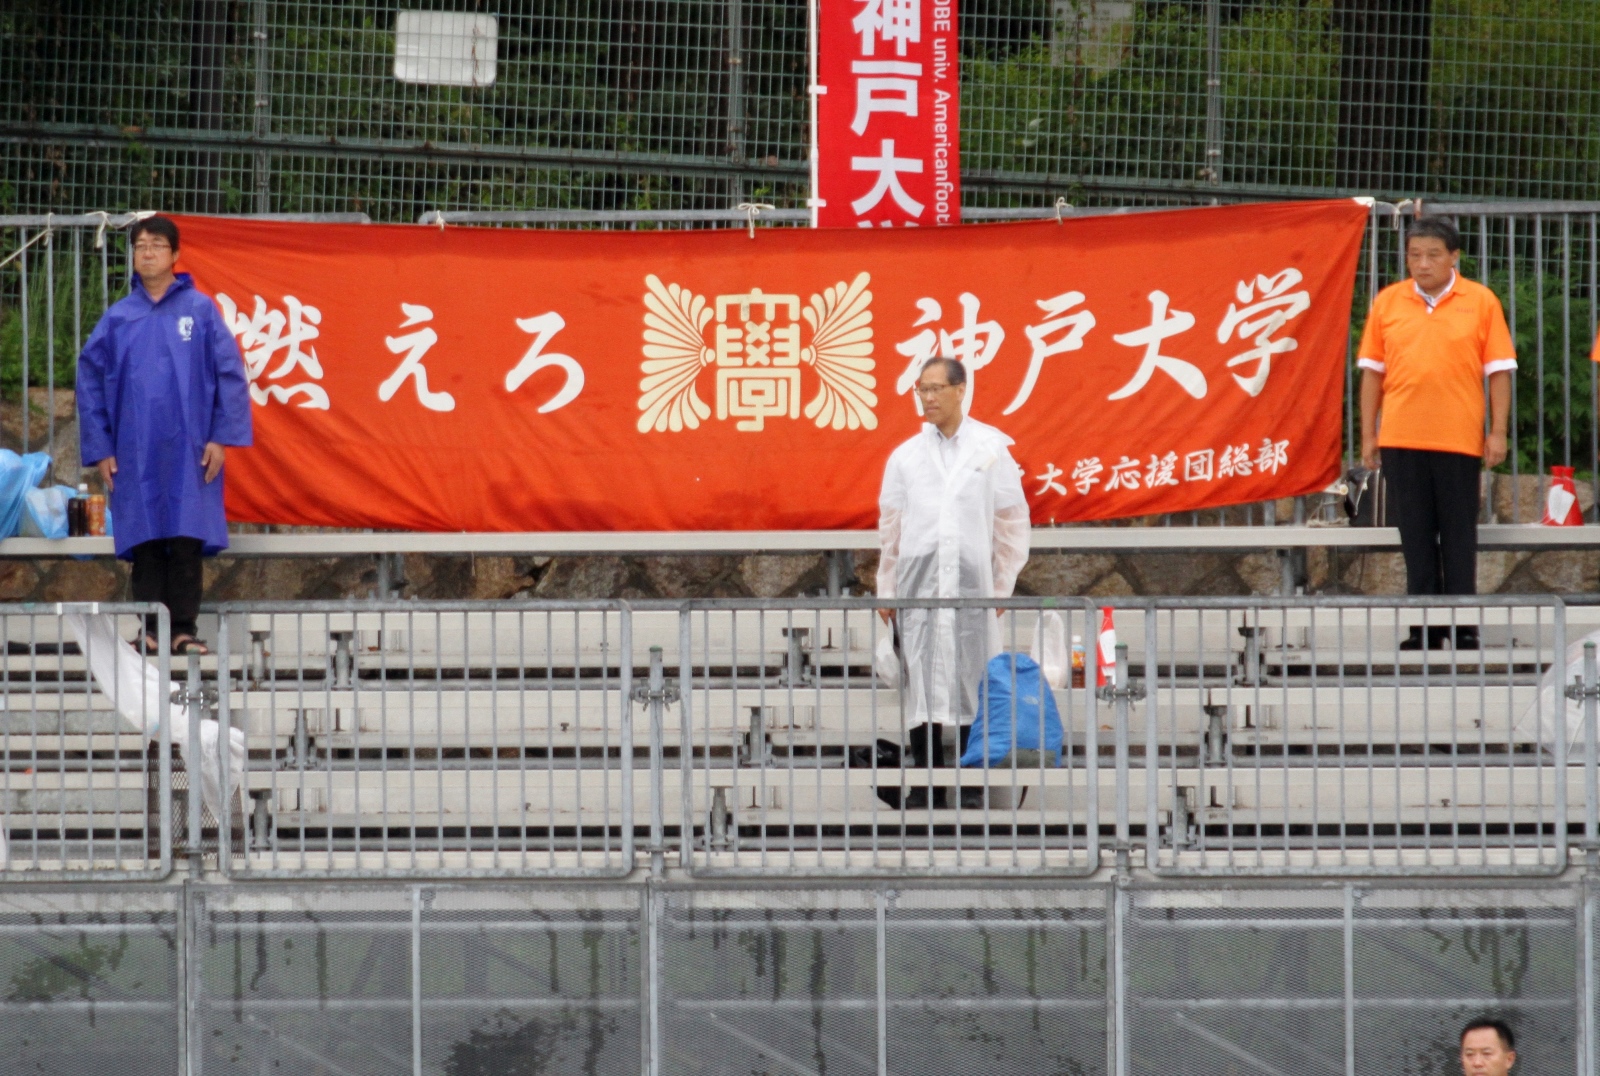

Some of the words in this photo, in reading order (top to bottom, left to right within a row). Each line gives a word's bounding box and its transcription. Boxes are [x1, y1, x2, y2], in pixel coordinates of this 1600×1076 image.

[851, 0, 925, 228] 神戸大
[933, 38, 951, 83] univ.
[934, 88, 954, 226] Americanfoot
[216, 292, 585, 414] 燃えろ
[896, 267, 1310, 417] 神戸大学
[1018, 438, 1290, 496] 大学応援団総部
